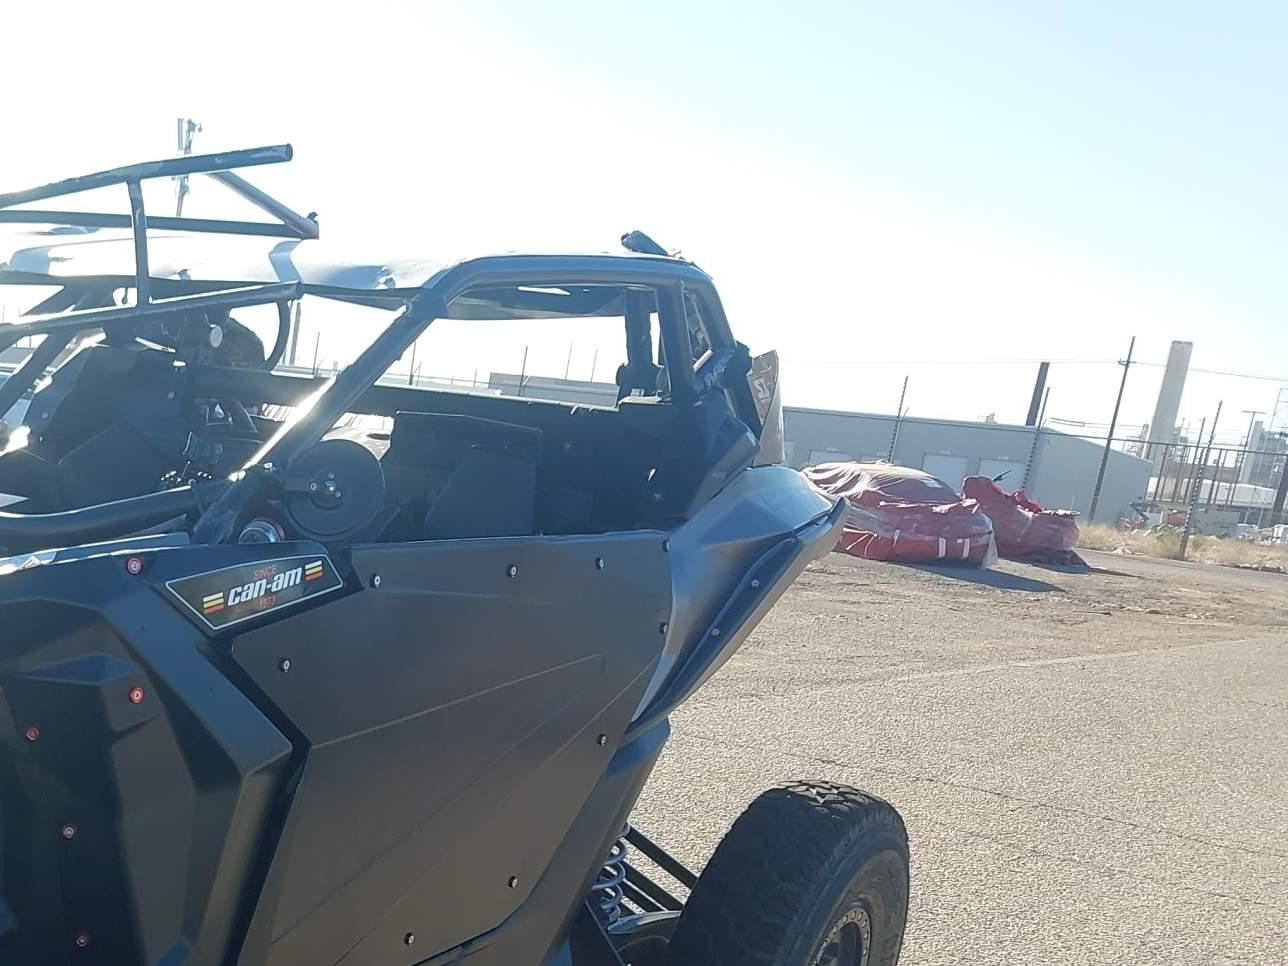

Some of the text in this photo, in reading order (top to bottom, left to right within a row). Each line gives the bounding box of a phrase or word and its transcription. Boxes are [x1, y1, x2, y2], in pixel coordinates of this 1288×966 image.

[253, 564, 278, 580] SINCE
[227, 567, 303, 607] can-am
[259, 595, 277, 610] 1973
